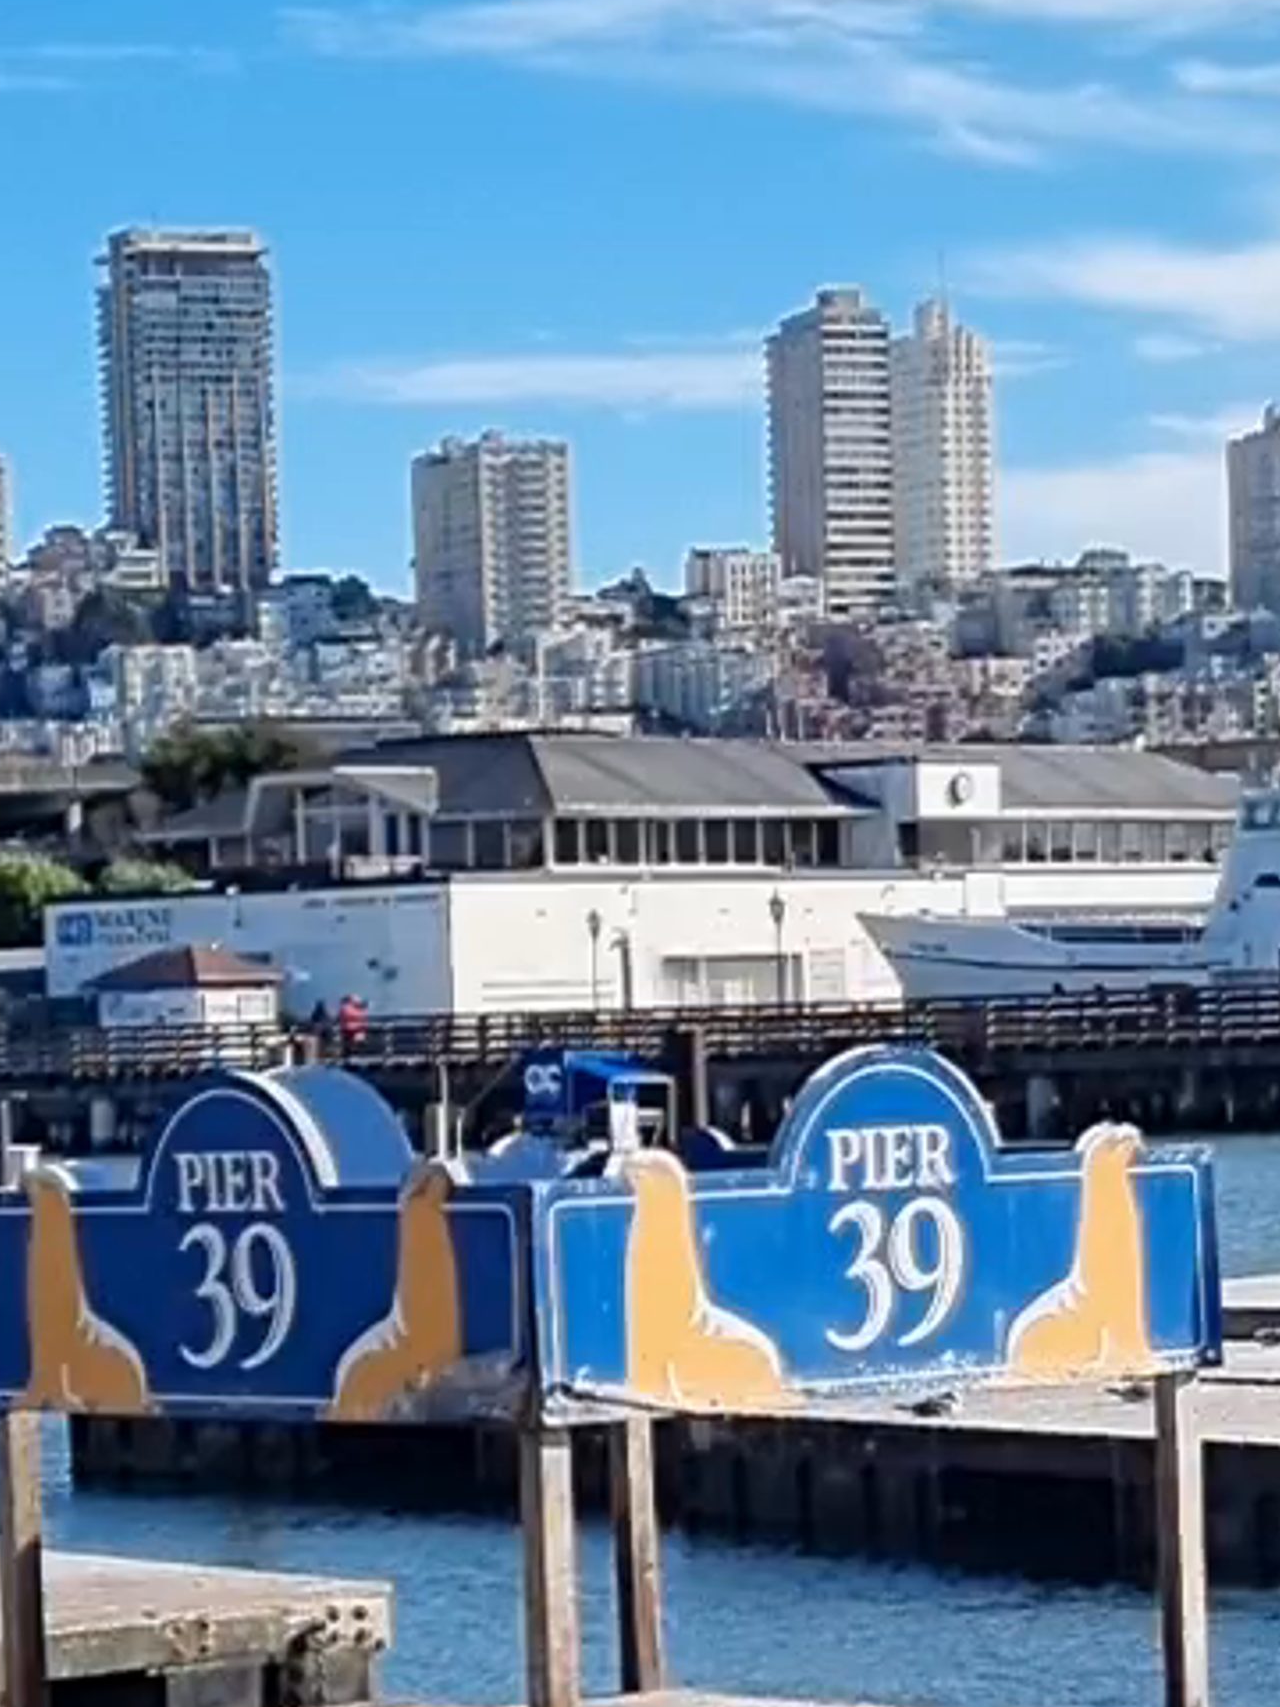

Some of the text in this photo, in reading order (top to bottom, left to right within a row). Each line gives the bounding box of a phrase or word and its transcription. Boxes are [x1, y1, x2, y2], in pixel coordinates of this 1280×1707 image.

[174, 1150, 286, 1213] PIER
[825, 1124, 955, 1192] PIER
[177, 1221, 297, 1369] 39
[825, 1196, 963, 1351] 39
